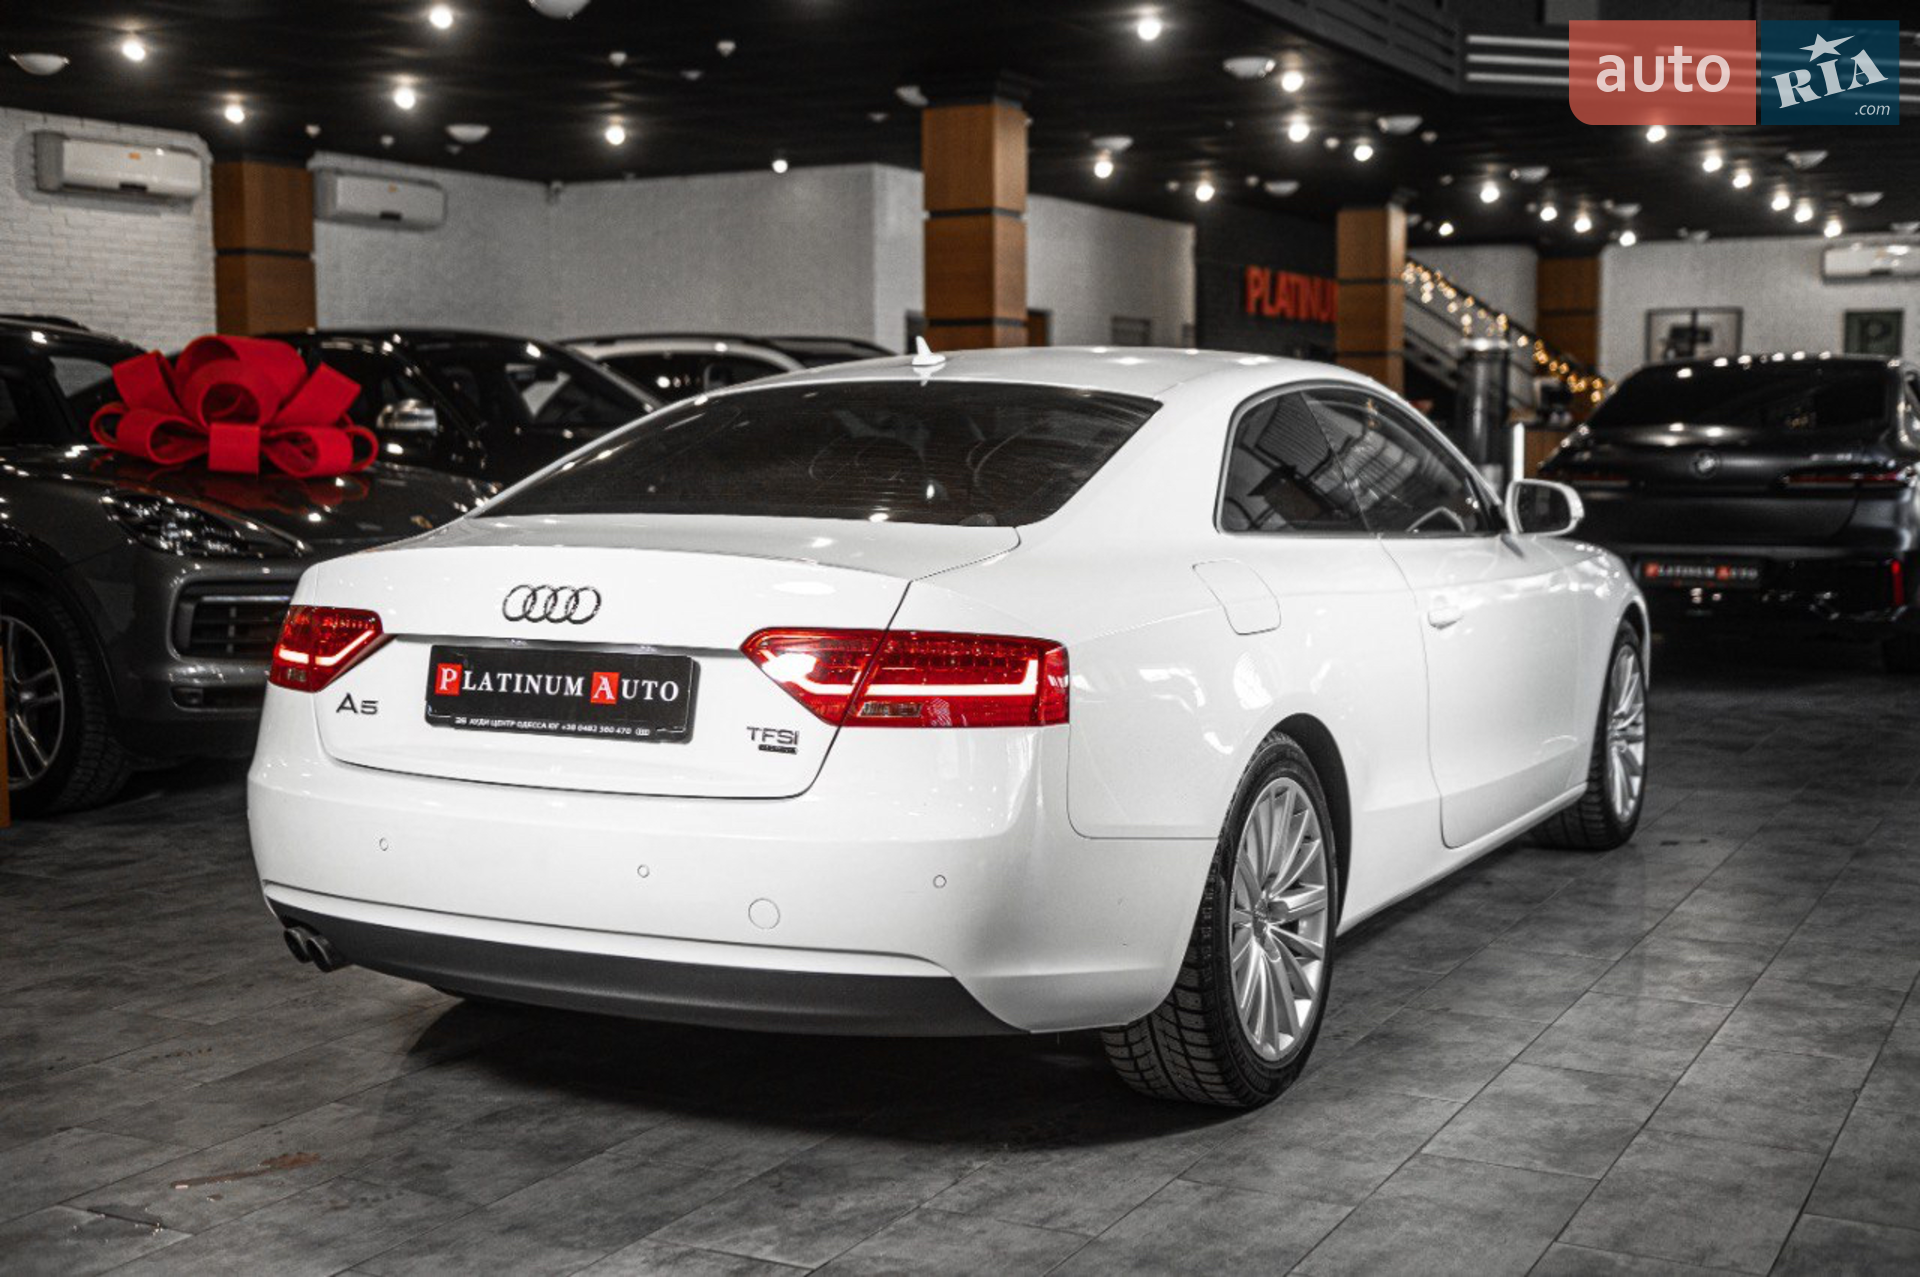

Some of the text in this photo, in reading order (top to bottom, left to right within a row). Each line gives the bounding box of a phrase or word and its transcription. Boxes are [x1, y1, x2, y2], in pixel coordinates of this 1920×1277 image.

[1246, 265, 1339, 321] PLATINU
[437, 666, 679, 703] PLATINUM AUTO
[336, 692, 379, 715] A5
[517, 721, 547, 729] ОДЕССА
[746, 726, 799, 745] TFSI
